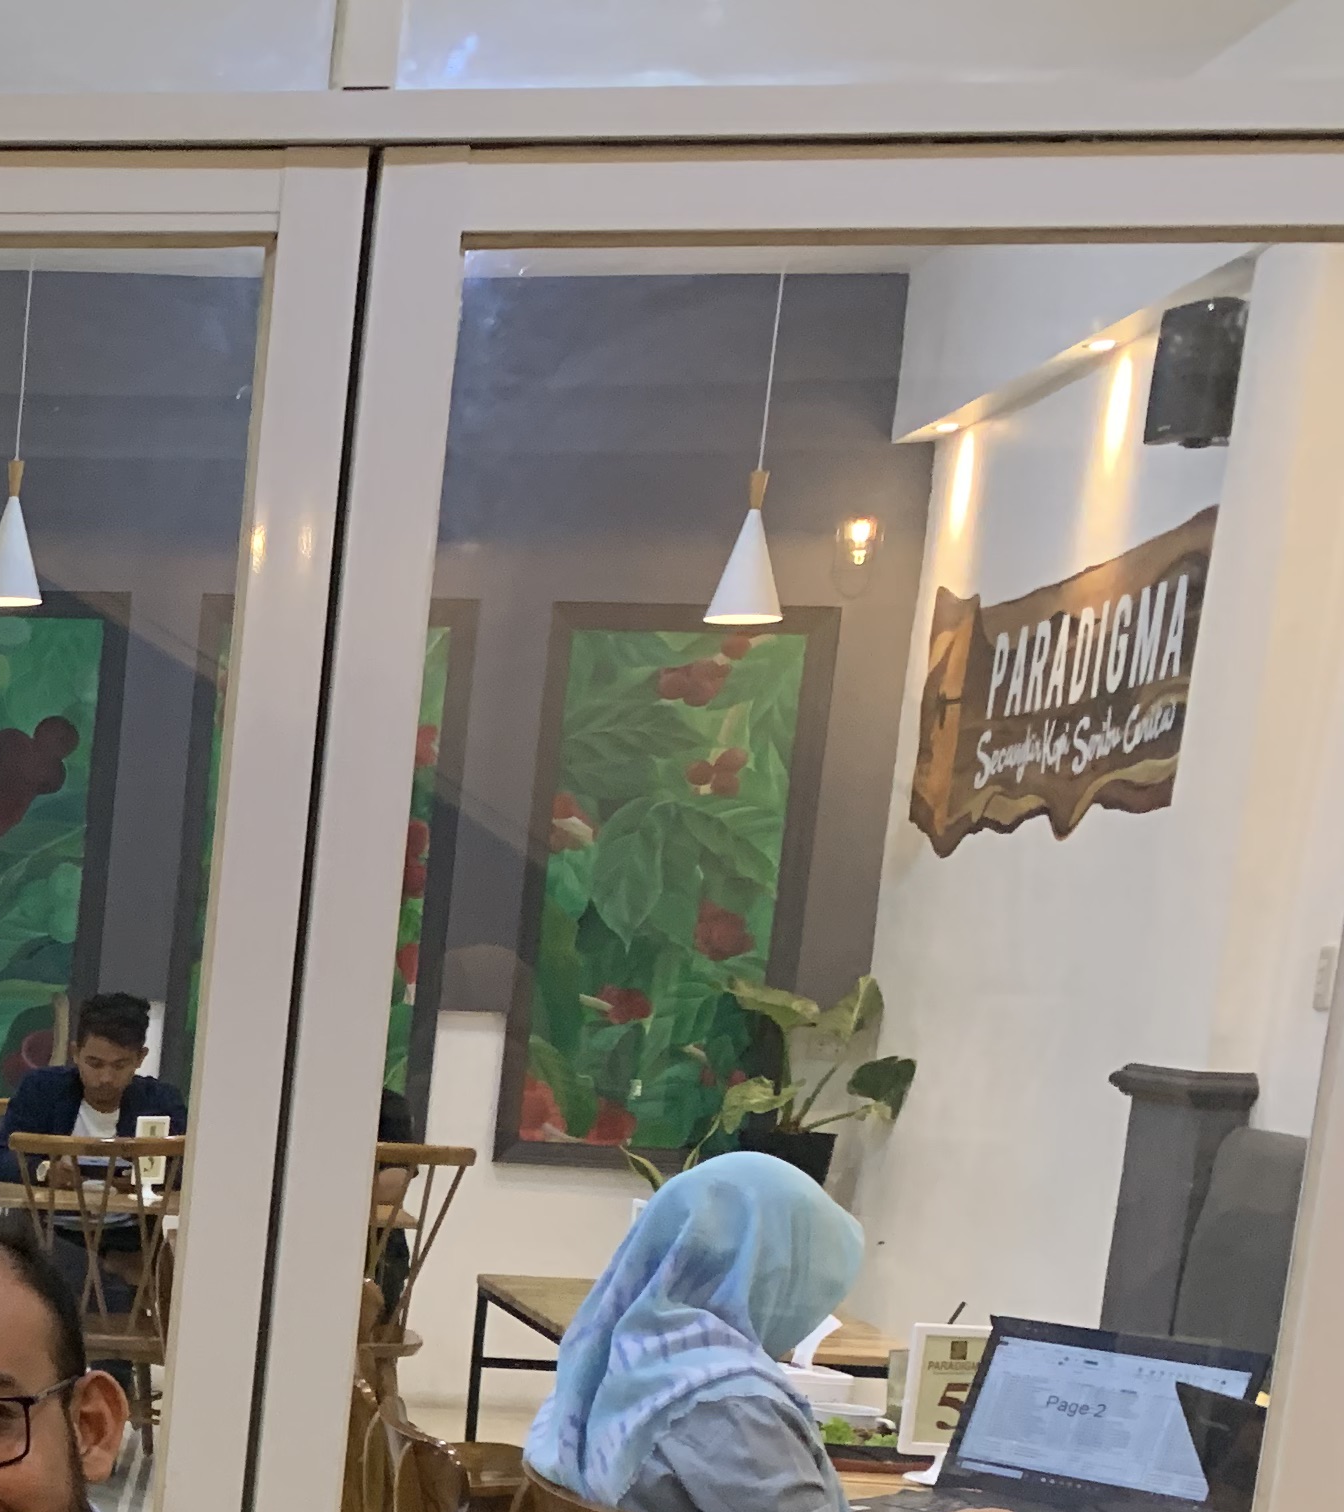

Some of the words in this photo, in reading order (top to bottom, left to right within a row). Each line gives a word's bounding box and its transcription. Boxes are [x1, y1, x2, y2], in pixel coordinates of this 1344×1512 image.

[986, 574, 1188, 720] PARADIGMA
[1040, 719, 1071, 775] Kopi
[936, 1383, 970, 1430] 5
[1046, 1395, 1090, 1418] Page
[1093, 1403, 1108, 1418] 2
